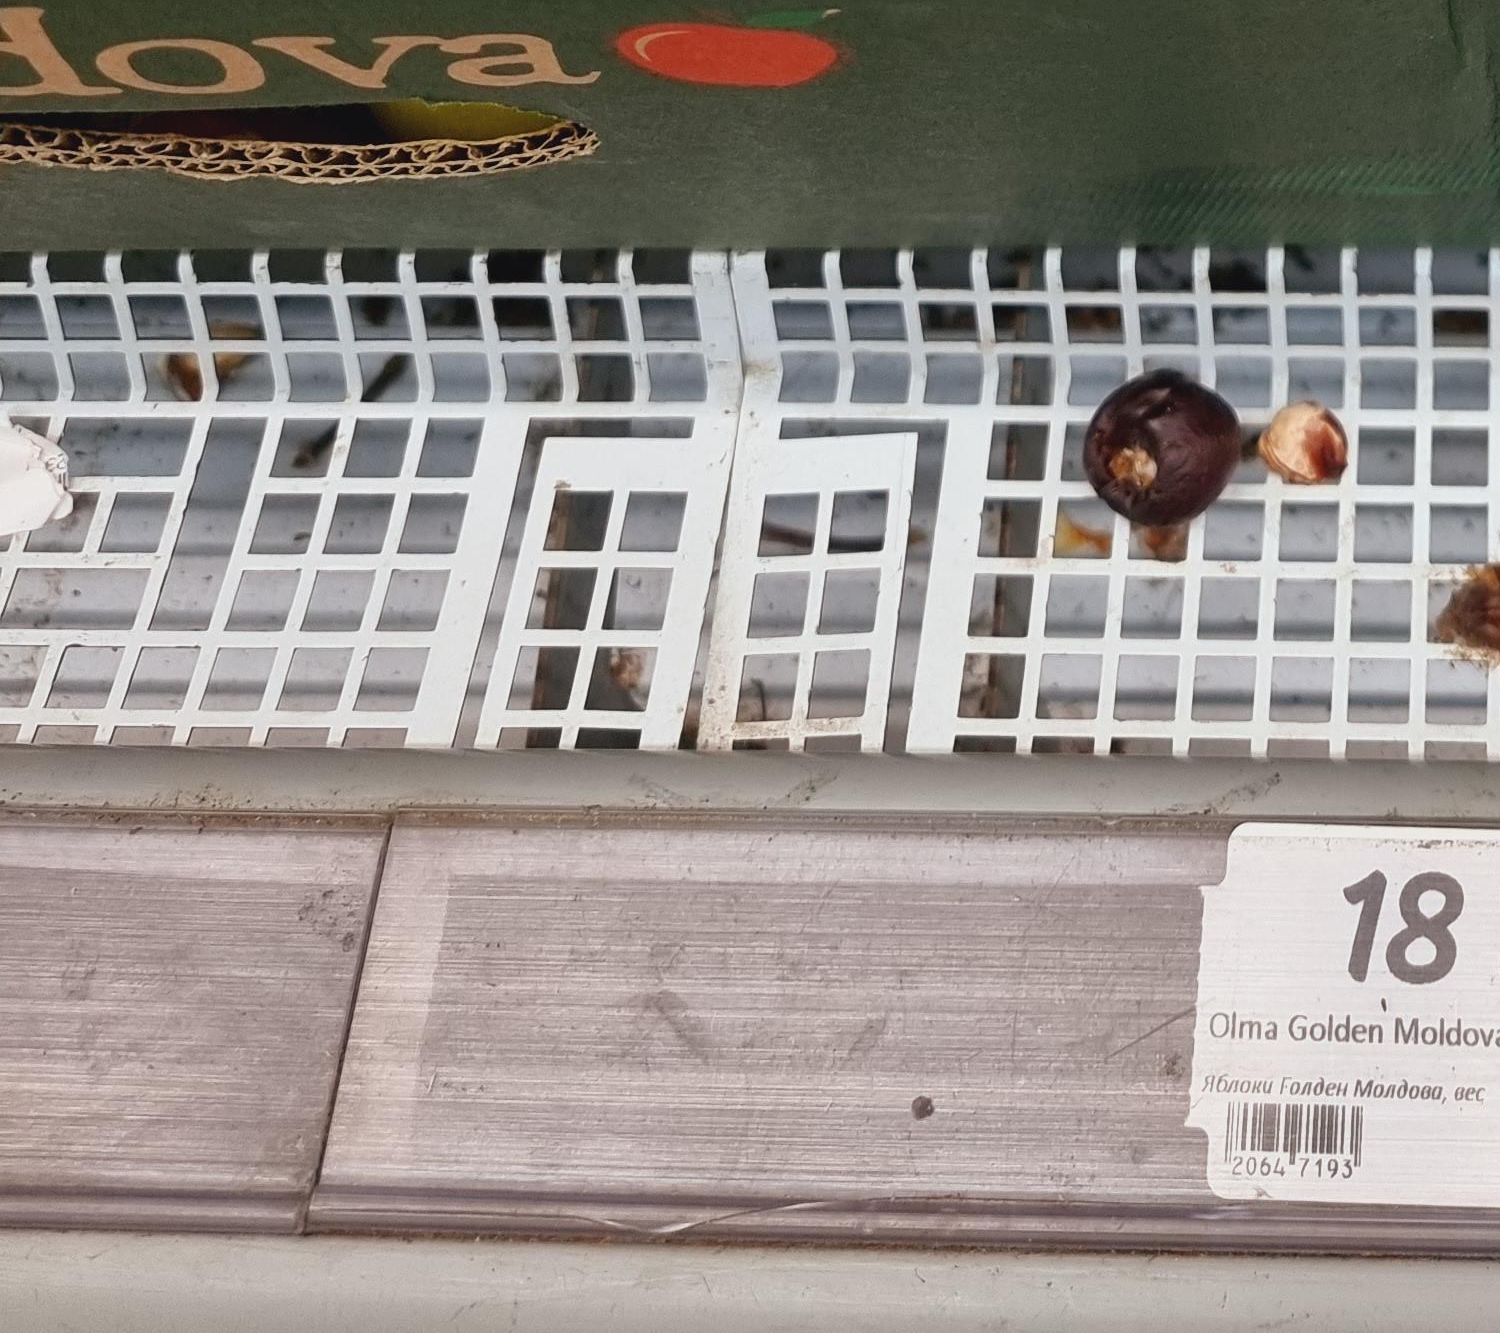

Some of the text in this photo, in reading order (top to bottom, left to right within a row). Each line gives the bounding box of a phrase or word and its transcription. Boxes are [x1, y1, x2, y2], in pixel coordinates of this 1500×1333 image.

[1342, 868, 1465, 985] 18
[1208, 1012, 1278, 1041] Olma
[1287, 1014, 1384, 1044] Golden
[1201, 1073, 1273, 1095] Яблоки
[1353, 1079, 1448, 1103] Молдова,
[1454, 1085, 1487, 1103] вес
[1232, 1156, 1353, 1179] 2064 7193
